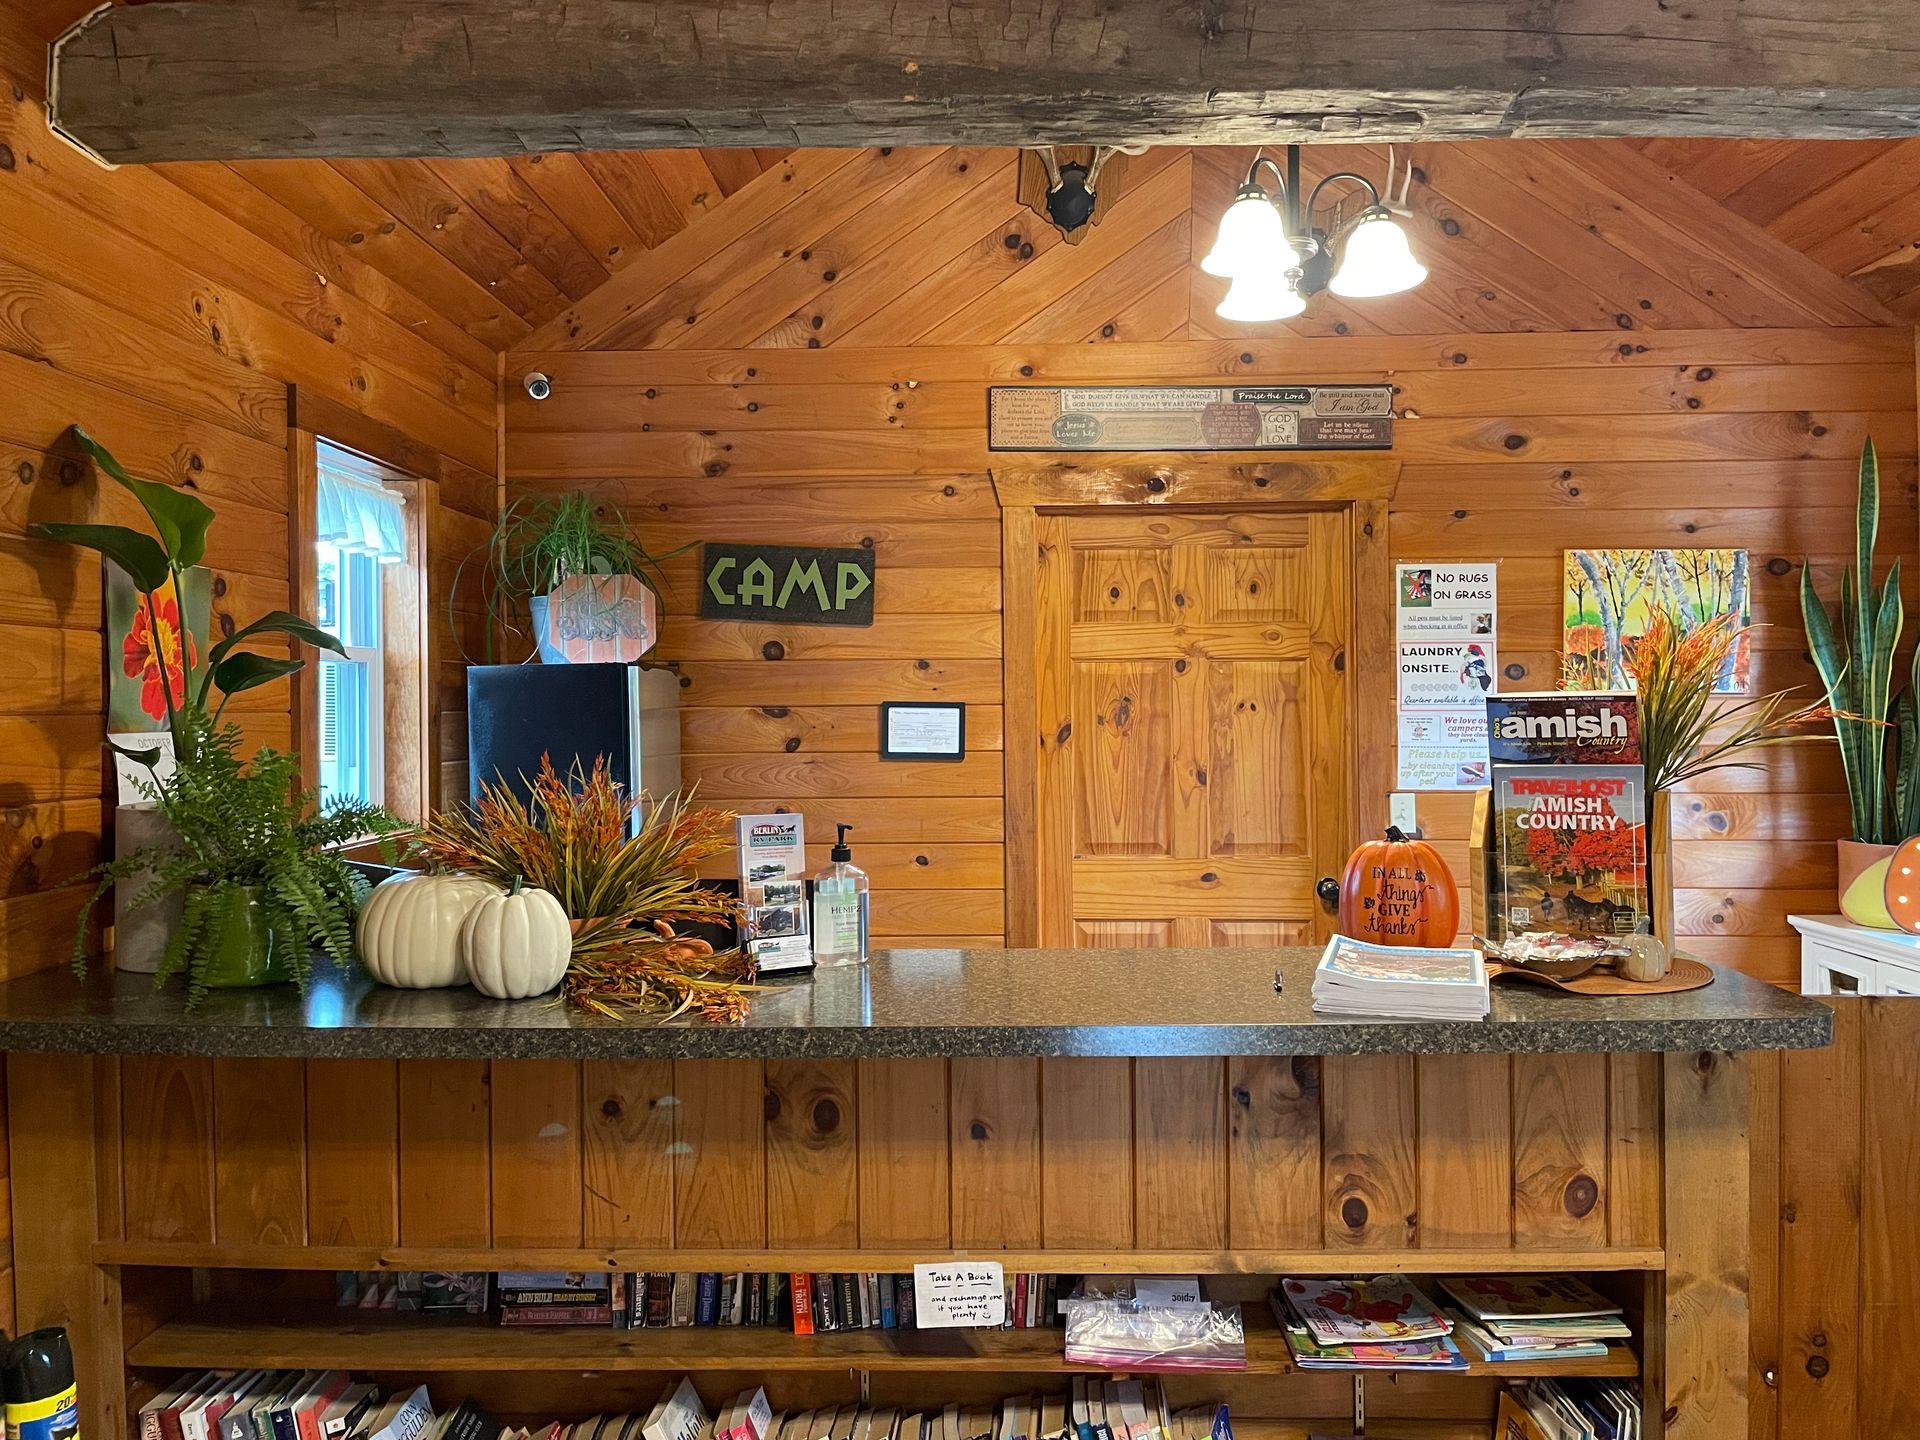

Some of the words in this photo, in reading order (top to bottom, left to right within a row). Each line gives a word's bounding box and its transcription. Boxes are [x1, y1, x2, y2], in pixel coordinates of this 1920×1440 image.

[1239, 392, 1265, 400] Praise
[1267, 391, 1280, 400] the
[1284, 392, 1306, 400] Lord
[1356, 399, 1381, 414] God
[1268, 414, 1292, 424] GOD
[1064, 420, 1086, 430] Jesus
[1275, 425, 1285, 433] IS
[1056, 429, 1079, 439] Loves
[1266, 435, 1293, 444] LOVE
[1436, 573, 1455, 583] NO
[1459, 573, 1489, 583] RUGS
[706, 556, 872, 612] CAMP
[1433, 590, 1451, 599] ON
[1455, 590, 1492, 599] GRASS
[1401, 647, 1463, 656] LAUNDRY
[1402, 664, 1459, 673] ONSITE...
[1404, 695, 1431, 705] Quarters
[1500, 708, 1628, 739] amish
[1447, 725, 1484, 733] campers
[137, 737, 172, 749] OCTOBER
[1576, 736, 1628, 754] Country
[1407, 749, 1442, 759] Please
[1444, 749, 1467, 760] help
[1419, 762, 1456, 771] cleaning
[1401, 770, 1412, 778] up
[1412, 769, 1435, 777] after
[1435, 770, 1456, 780] your
[1508, 778, 1627, 797] TRAVELHOST
[1531, 796, 1602, 813] AMISH
[1516, 813, 1620, 831] COUNTRY
[1372, 867, 1386, 879] IN
[1388, 867, 1412, 880] ALL
[1377, 880, 1433, 909] things
[1378, 903, 1411, 917] GIVE
[1364, 913, 1428, 935] thanks
[929, 1272, 952, 1282] Take
[956, 1273, 964, 1281] A
[968, 1272, 994, 1281] Book
[517, 1293, 534, 1303] ANN
[534, 1293, 552, 1303] RULE
[794, 1289, 803, 1314] TRUTH
[949, 1295, 987, 1303] exchange
[938, 1304, 944, 1312] if
[952, 1311, 977, 1320] plenty
[56, 1396, 71, 1412] 20
[400, 1400, 419, 1427] CONN
